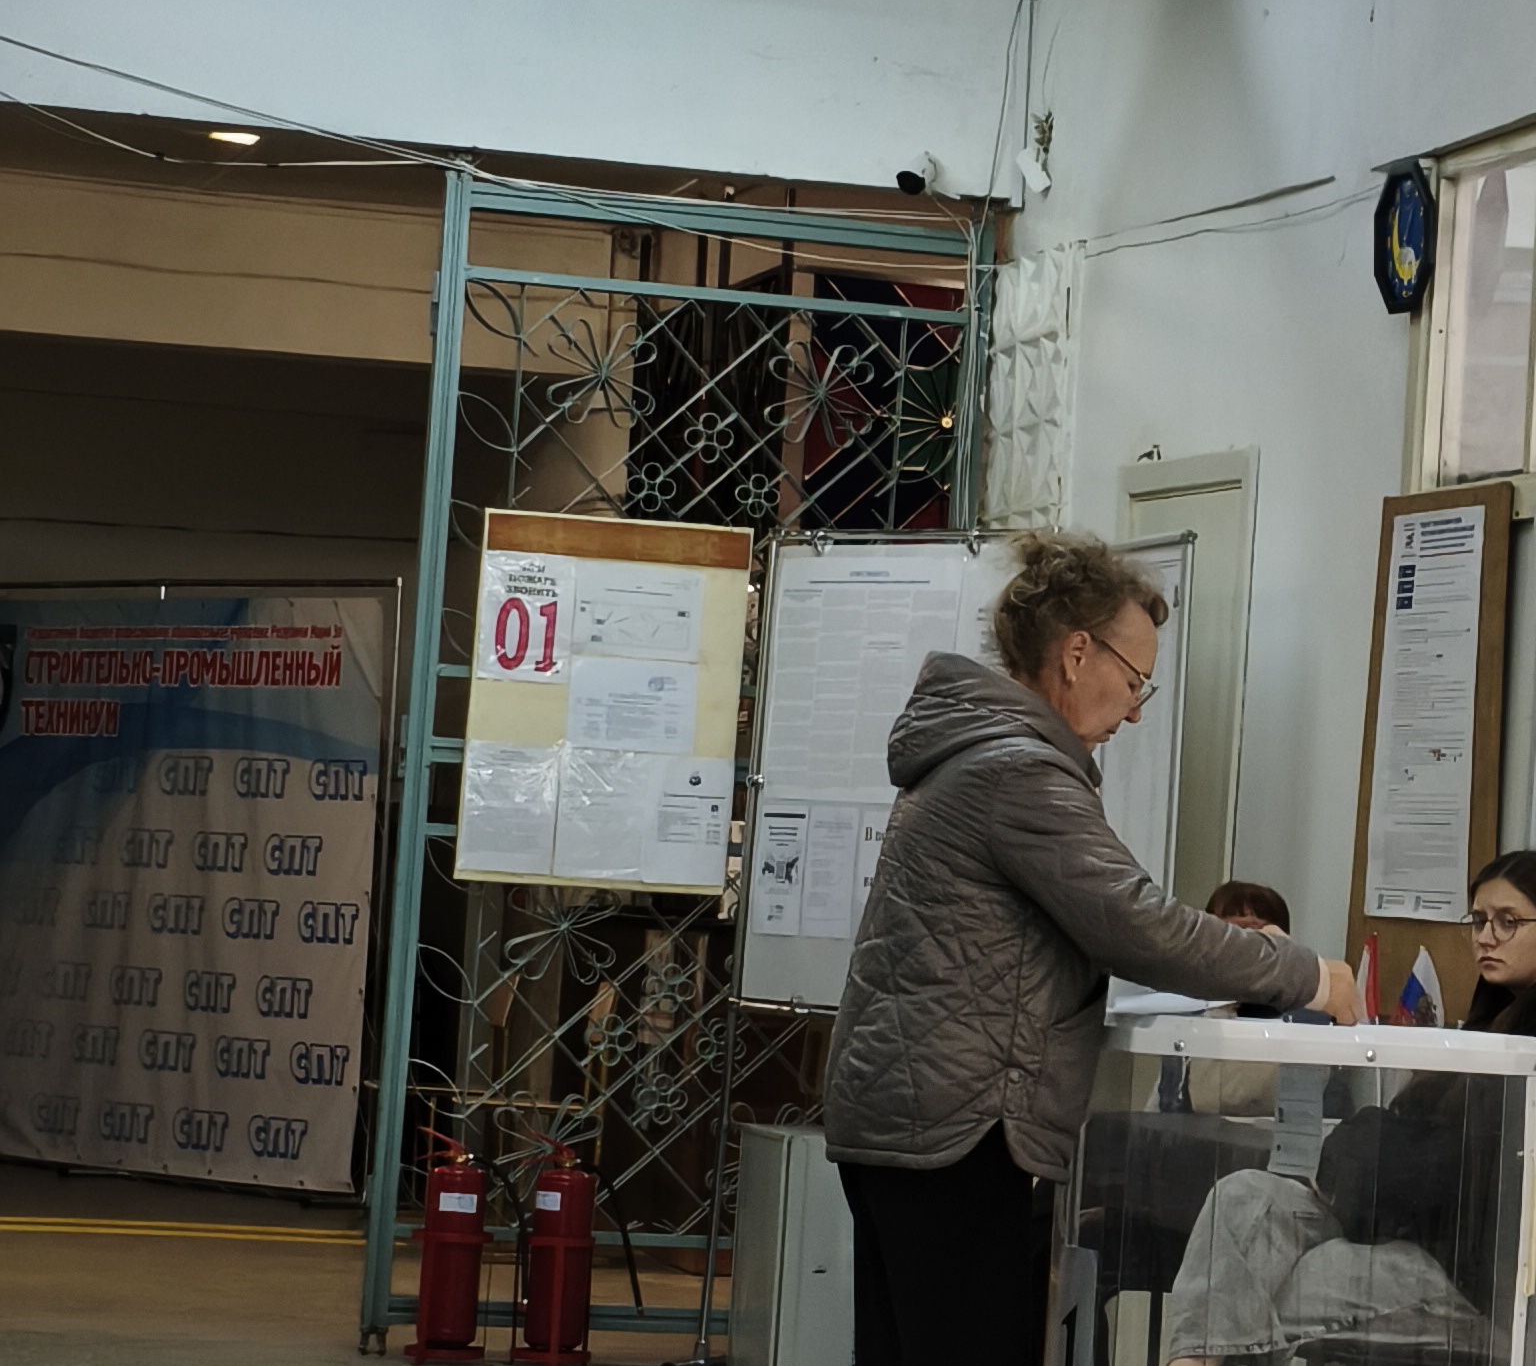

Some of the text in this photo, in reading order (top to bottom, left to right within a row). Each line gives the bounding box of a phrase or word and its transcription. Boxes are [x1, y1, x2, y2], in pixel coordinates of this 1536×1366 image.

[495, 597, 559, 673] 01
[158, 755, 213, 796] СПТ
[234, 757, 290, 799] СПТ
[308, 759, 366, 801] СПТ
[192, 831, 248, 874] СПТ
[264, 833, 322, 876] СПТ
[148, 893, 206, 936] СПТ
[222, 897, 280, 941] СПТ
[297, 901, 360, 944] СПТ
[110, 966, 162, 1007] СПТ
[184, 970, 237, 1014] СПТ
[256, 975, 313, 1019] СПТ
[139, 1029, 197, 1074] СПТ
[214, 1035, 271, 1081] СПТ
[289, 1042, 350, 1087] СПТ
[98, 1101, 154, 1144] СПТ
[172, 1108, 229, 1152] СПТ
[247, 1114, 308, 1161] СПТ
